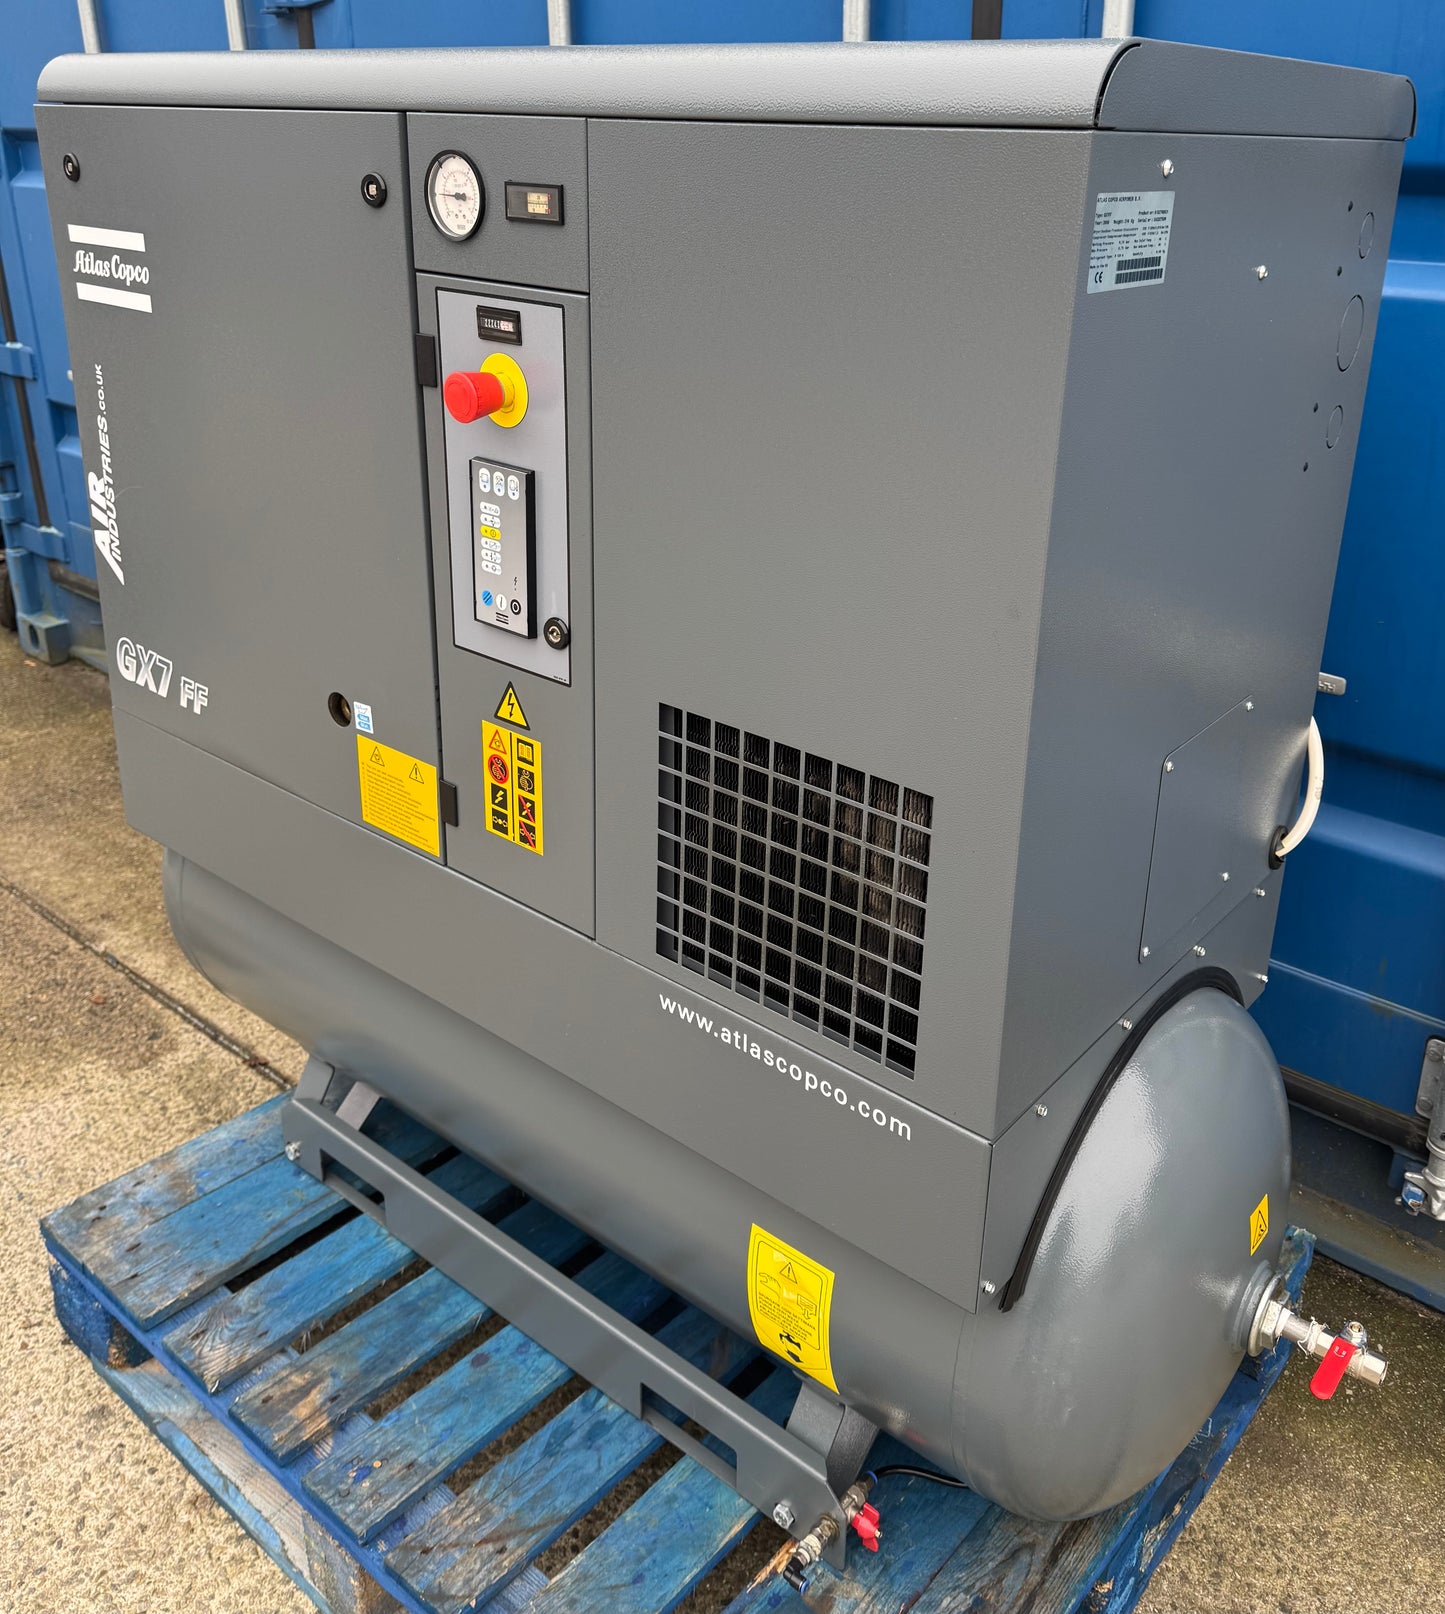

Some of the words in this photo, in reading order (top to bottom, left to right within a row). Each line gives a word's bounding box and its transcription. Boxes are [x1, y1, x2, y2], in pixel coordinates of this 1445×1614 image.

[73, 250, 110, 278] Atlas
[111, 255, 149, 287] Copco
[88, 471, 125, 586] AIR
[116, 637, 173, 698] GX7
[180, 676, 208, 715] FF
[659, 993, 912, 1141] www.atlascopco.com
